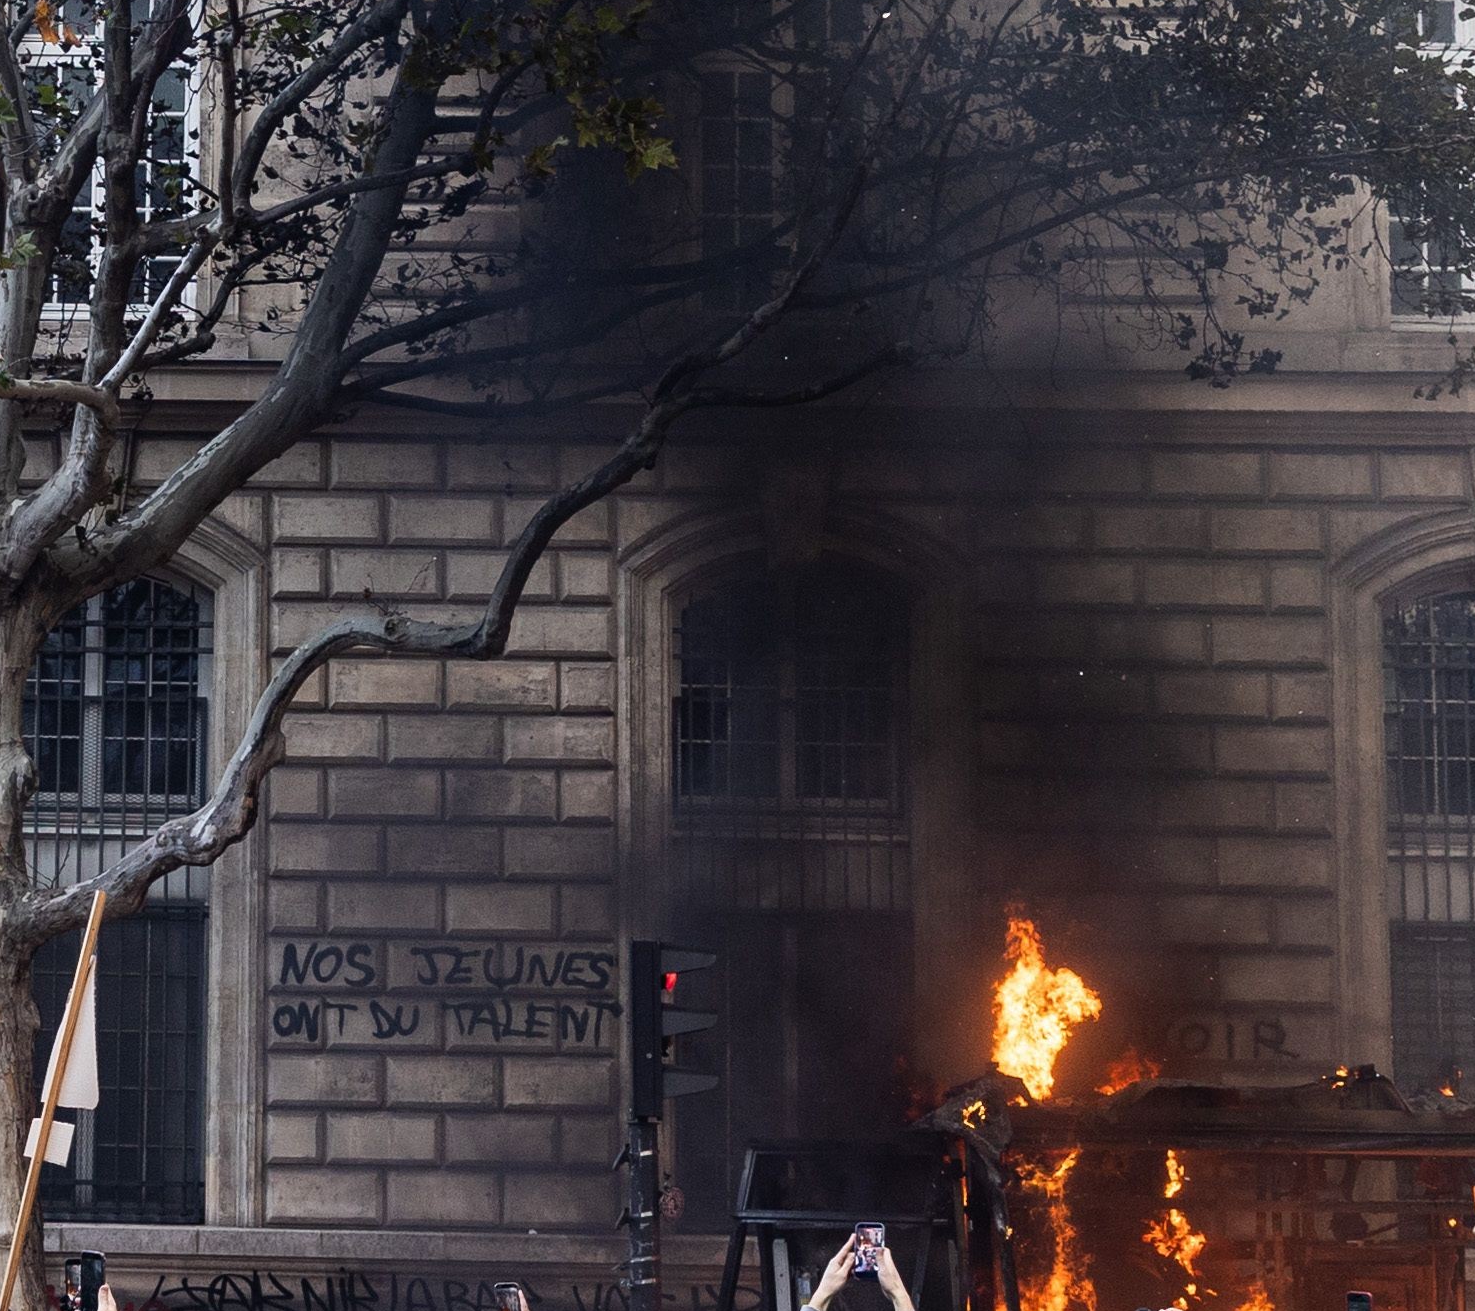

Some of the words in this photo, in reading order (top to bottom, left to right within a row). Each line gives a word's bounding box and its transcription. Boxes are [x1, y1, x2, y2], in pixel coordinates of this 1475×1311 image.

[280, 942, 375, 987] NOS
[410, 945, 617, 990] JEUNES
[272, 999, 358, 1041] ONT
[369, 999, 420, 1040] DU
[442, 999, 624, 1047] TALENT
